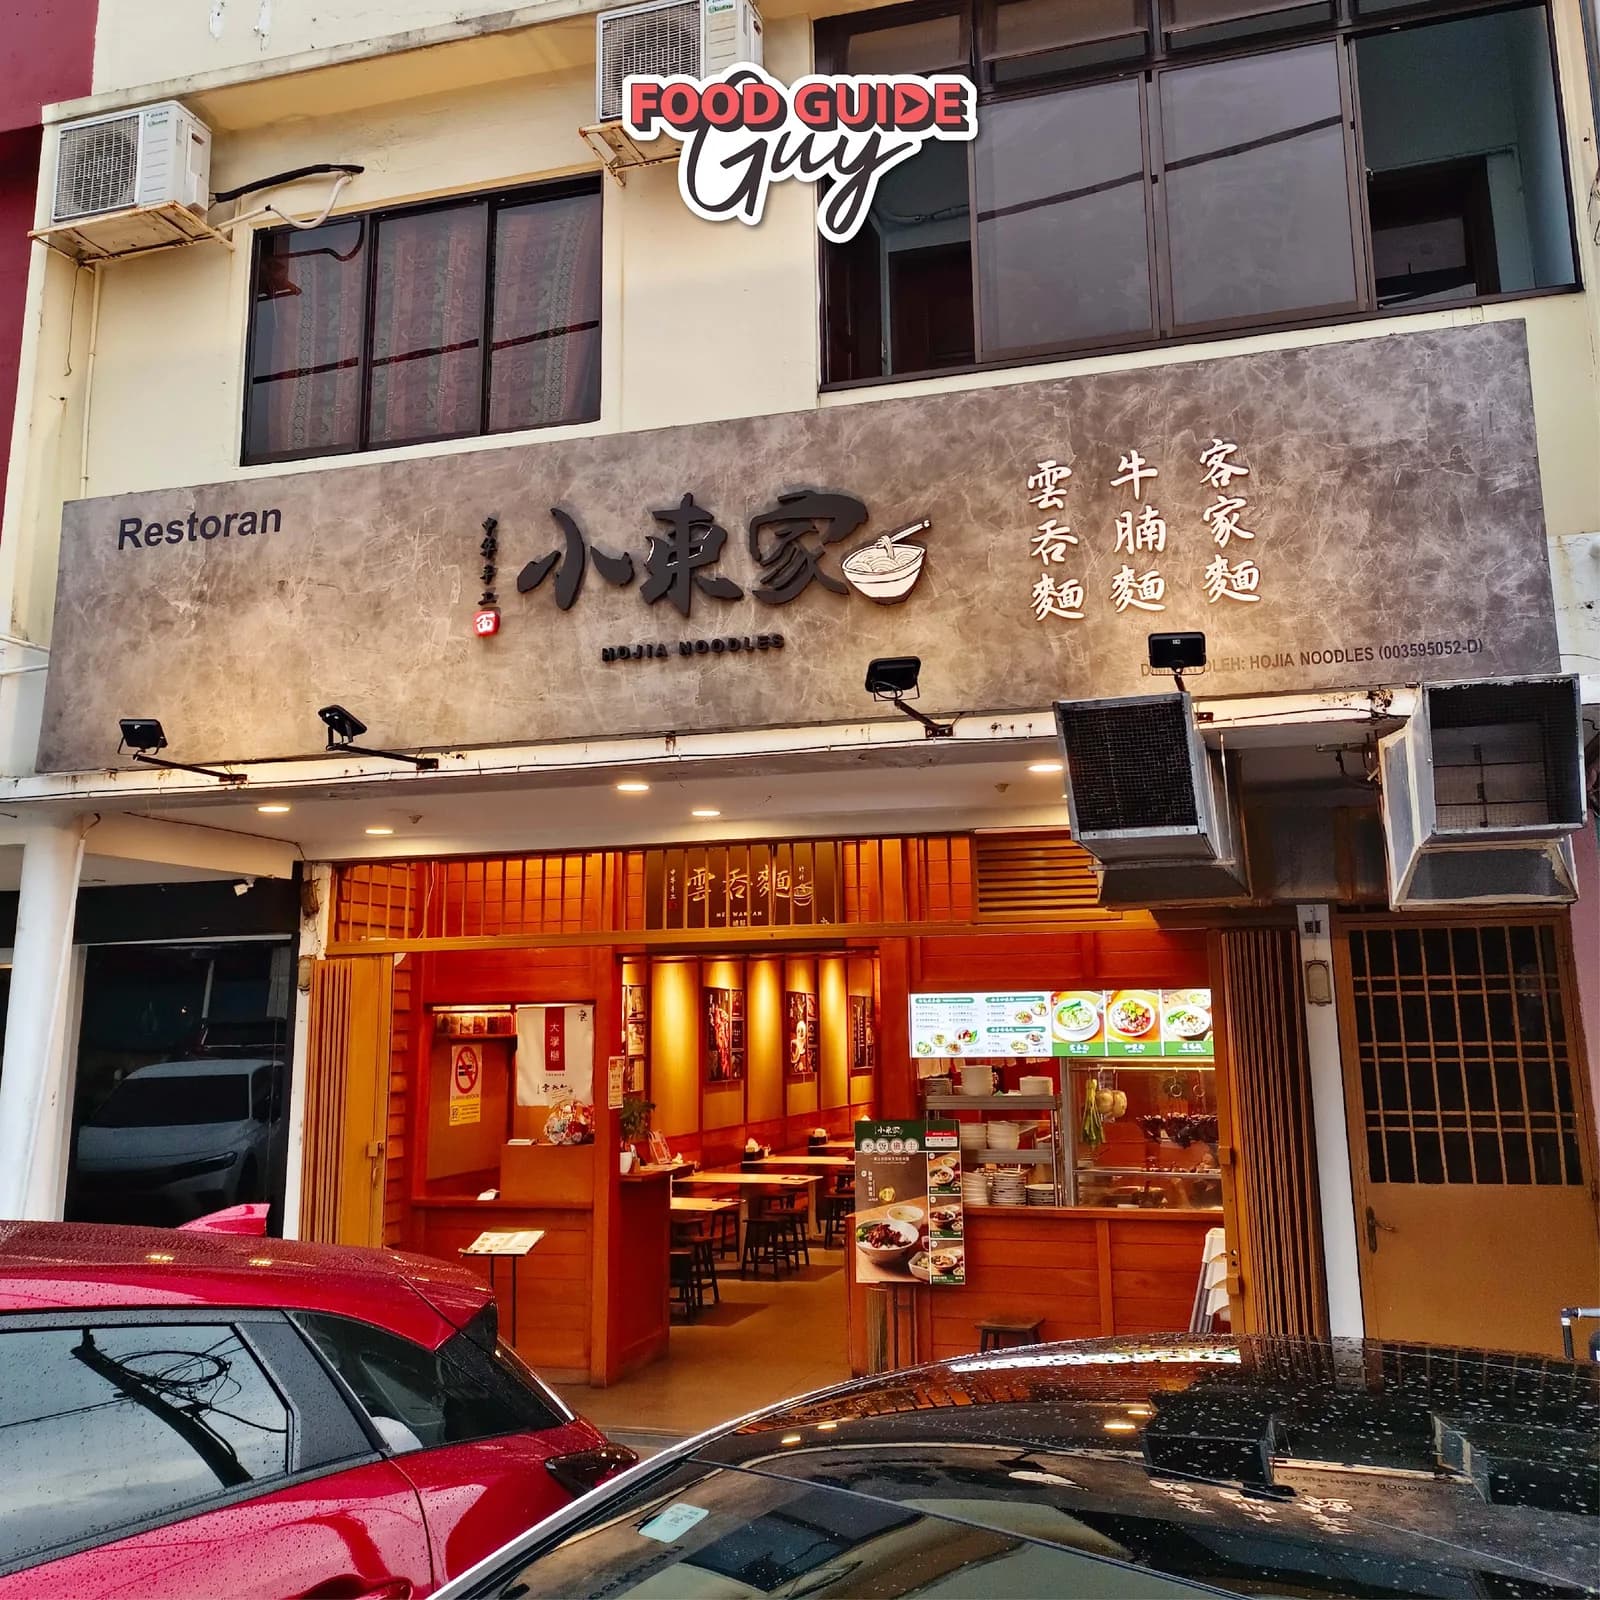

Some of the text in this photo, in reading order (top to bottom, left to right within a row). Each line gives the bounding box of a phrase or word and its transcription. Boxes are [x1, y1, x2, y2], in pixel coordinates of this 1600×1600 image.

[117, 507, 282, 550] Restoran
[517, 490, 868, 617] 小東家
[1027, 460, 1085, 621] 雲吞麵
[1110, 450, 1166, 613] 牛腩麵
[1200, 439, 1261, 604] 客家麵
[602, 633, 784, 662] HOJIA NOODLES
[1250, 655, 1293, 670] HOJIA
[1300, 645, 1374, 665] NOODLES
[1379, 638, 1483, 660] (003595052-D)
